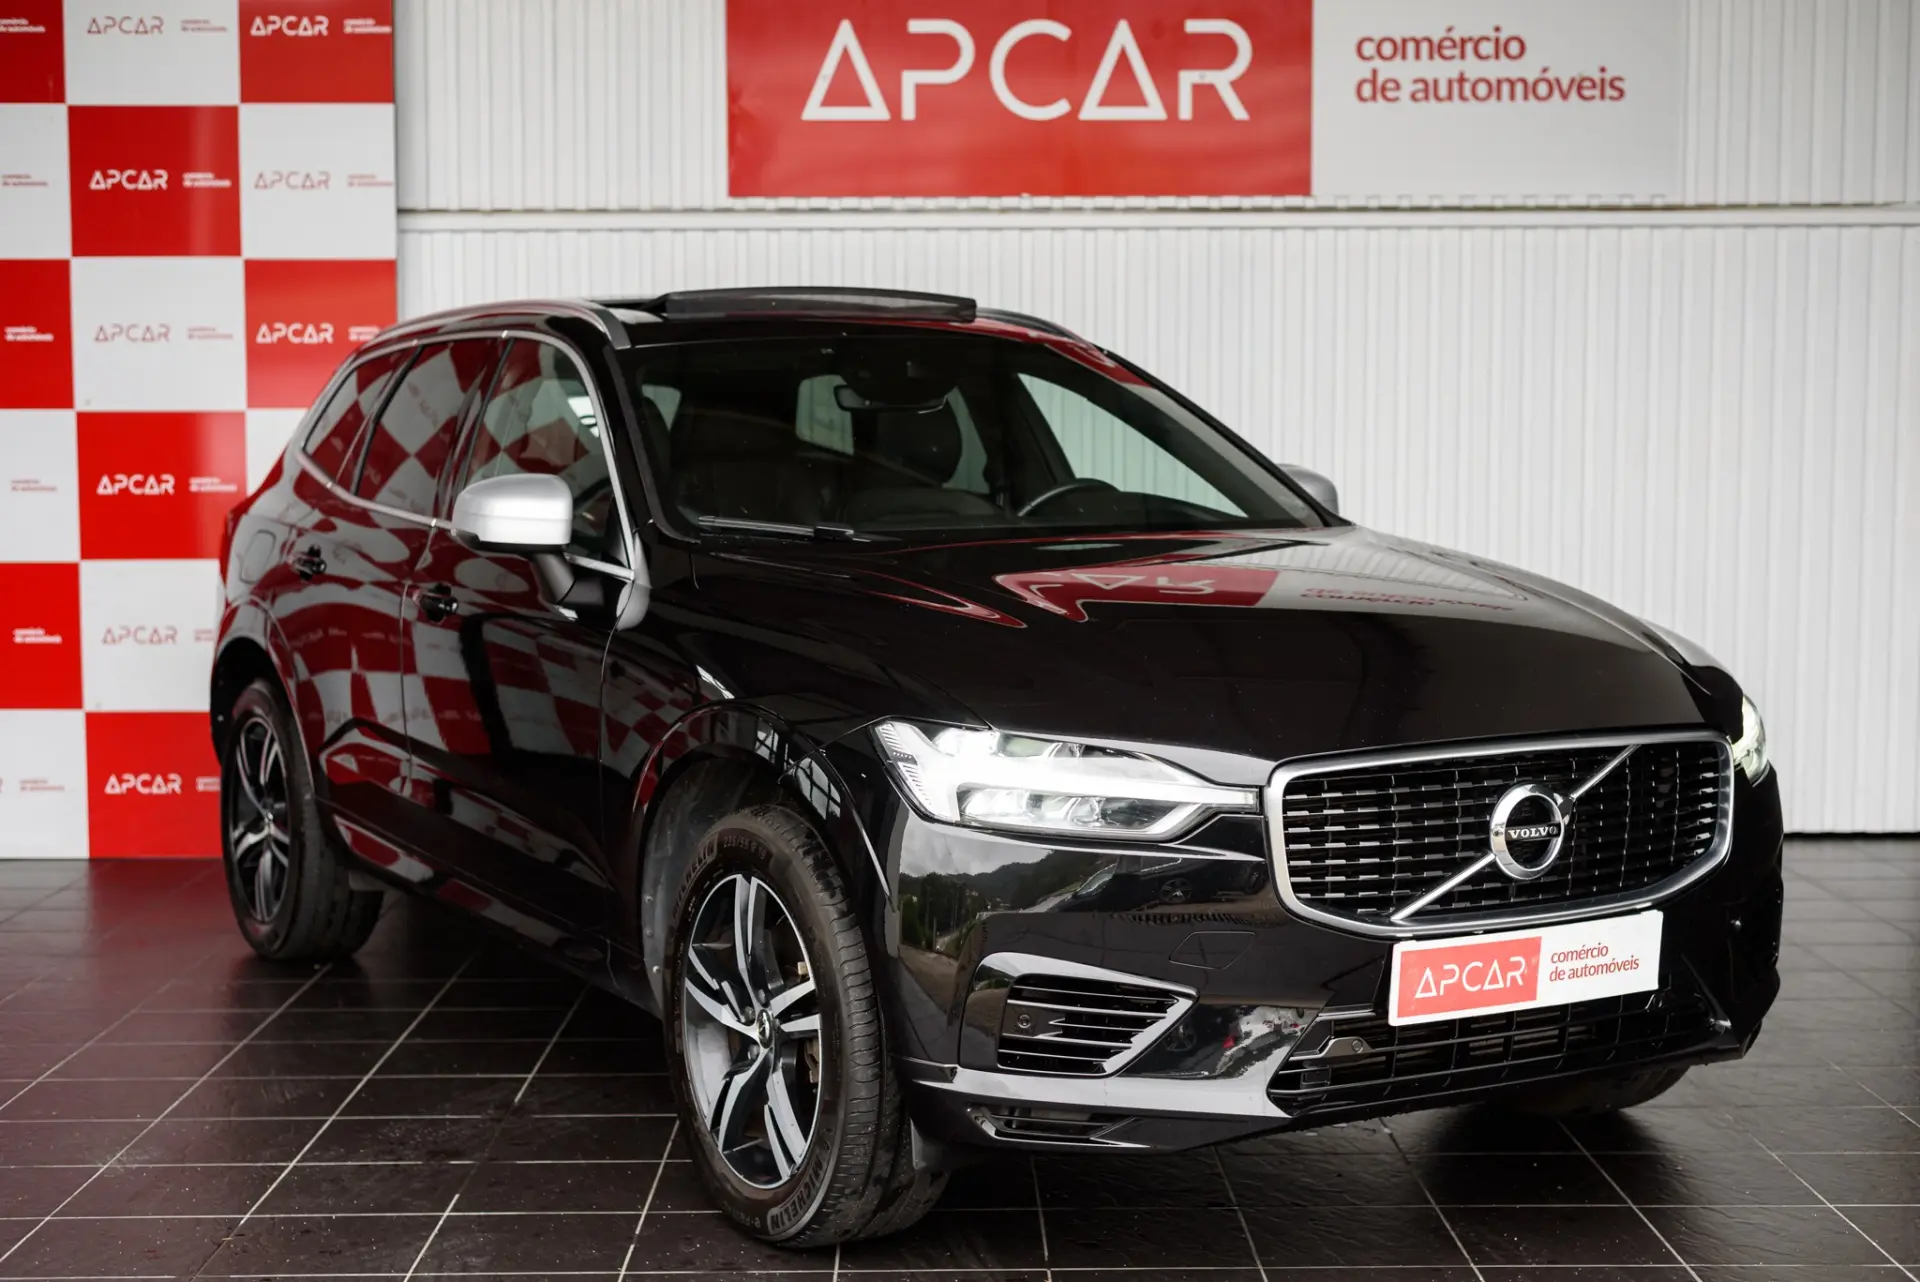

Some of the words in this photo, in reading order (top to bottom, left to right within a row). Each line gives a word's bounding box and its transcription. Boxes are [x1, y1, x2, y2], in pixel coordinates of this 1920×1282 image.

[87, 16, 164, 35] APCAR
[250, 16, 329, 37] APCAR
[1356, 26, 1526, 62] comércio
[801, 17, 1253, 122] APCAR
[1355, 68, 1401, 103] de
[1410, 66, 1626, 103] automóveis
[89, 169, 169, 191] APCAR
[253, 171, 331, 191] APCAR
[94, 323, 171, 343] APCAR
[256, 323, 334, 344] APCAR
[97, 474, 176, 496] APCAR
[102, 626, 178, 646] APCAR
[105, 774, 182, 795] APCAR
[1507, 825, 1559, 839] VOLVO
[1551, 942, 1609, 964] comércio
[1414, 955, 1528, 999] APCAR
[1549, 965, 1565, 982] de
[1568, 955, 1640, 980] automóveis
[770, 1155, 823, 1231] MICHELIN
